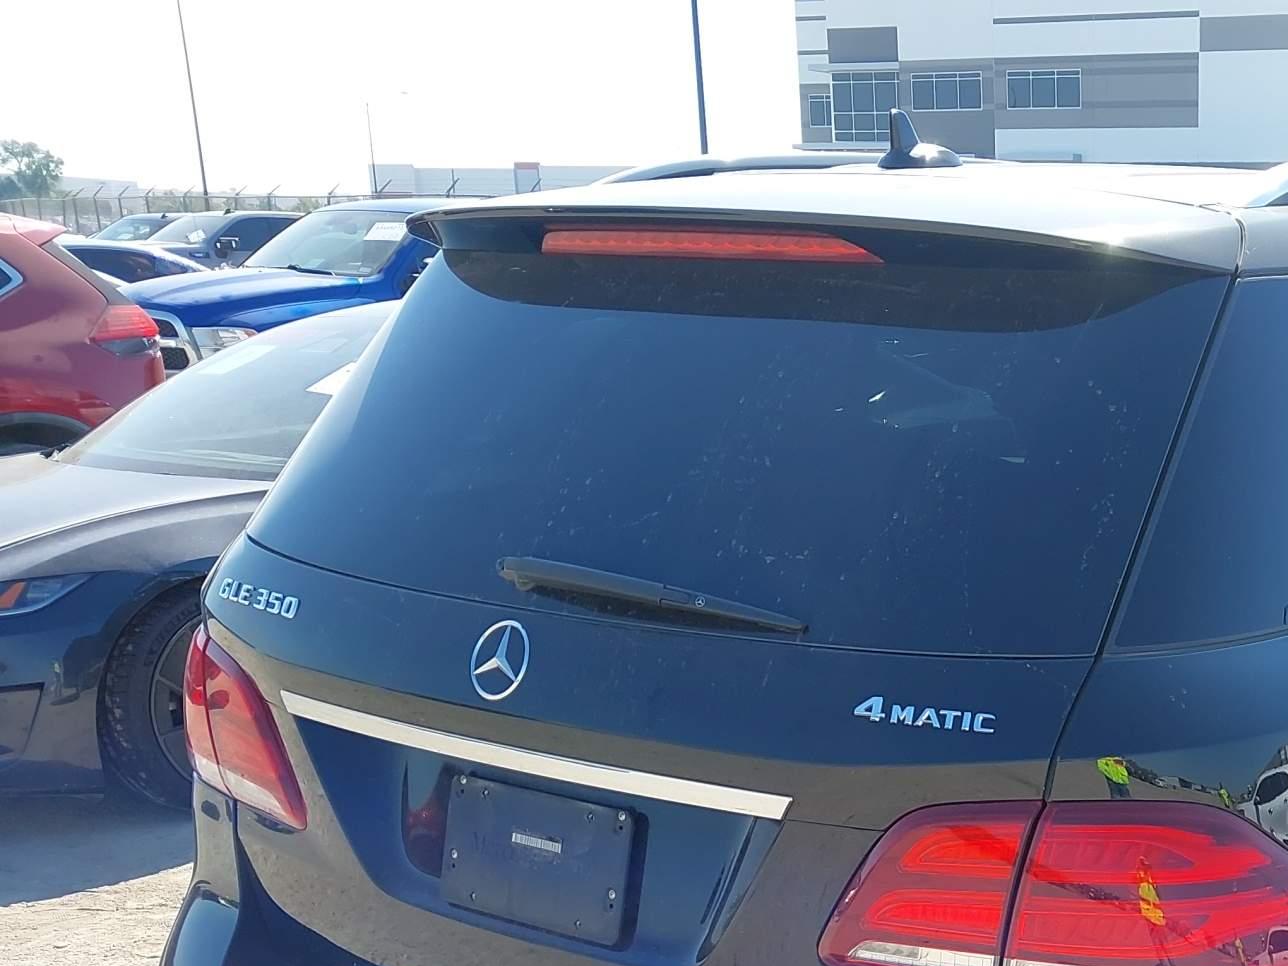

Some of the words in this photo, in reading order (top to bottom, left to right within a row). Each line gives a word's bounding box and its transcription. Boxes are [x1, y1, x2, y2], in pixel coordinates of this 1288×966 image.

[219, 578, 254, 606] GLE
[253, 588, 299, 619] 350
[853, 696, 996, 733] 4MATIC
